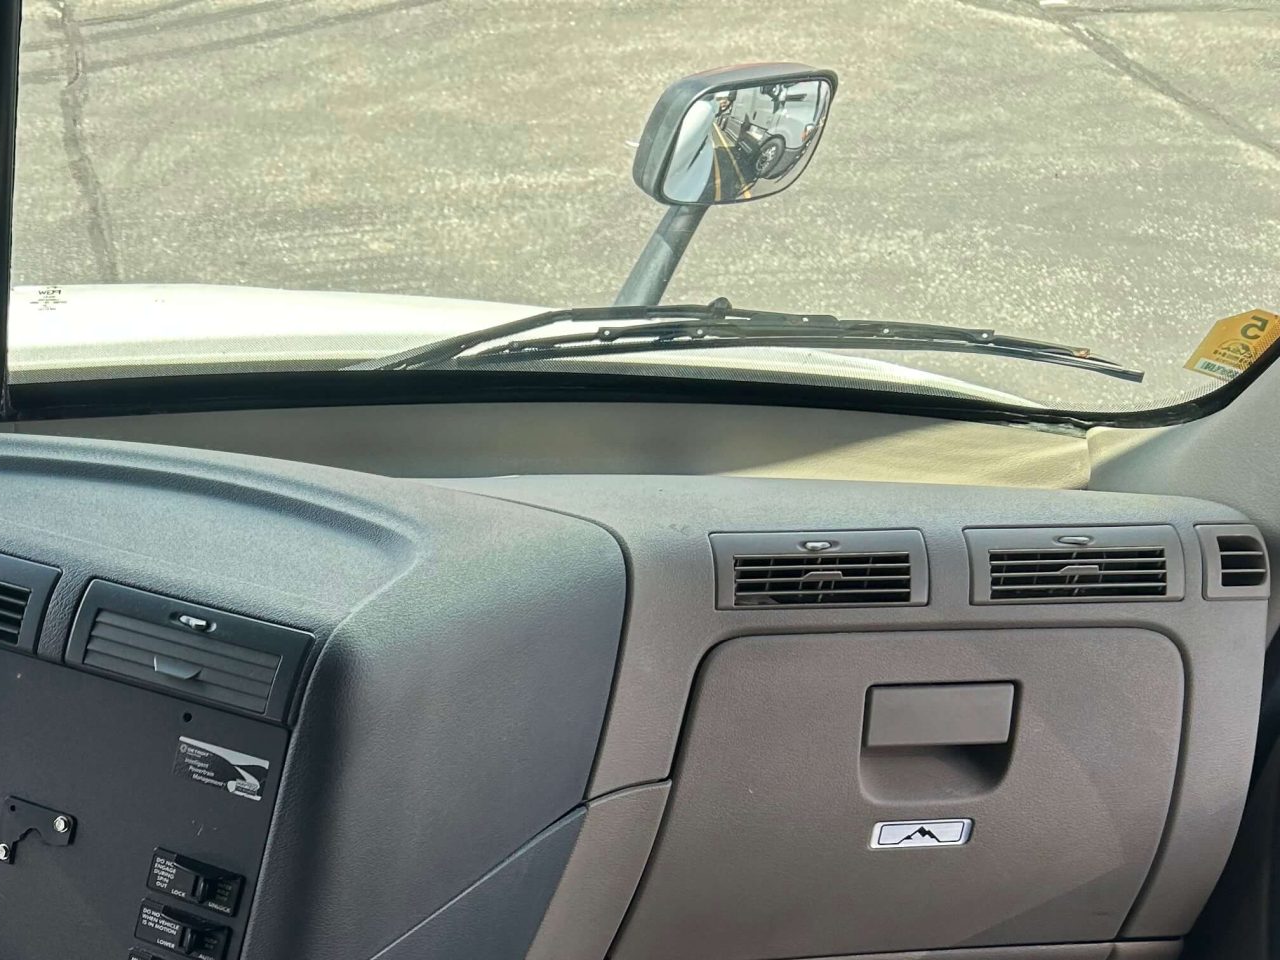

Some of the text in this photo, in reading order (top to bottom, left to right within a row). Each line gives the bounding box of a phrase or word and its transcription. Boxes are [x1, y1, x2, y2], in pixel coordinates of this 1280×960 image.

[154, 862, 176, 874] ENGAGE
[154, 868, 174, 880] DURING
[157, 876, 170, 884] SPIN
[172, 888, 186, 898] LOCK
[208, 902, 231, 914] UNLOCK
[142, 914, 180, 930] WHEN VEHICLE
[155, 924, 177, 936] MOTION
[156, 938, 175, 949] LOWER
